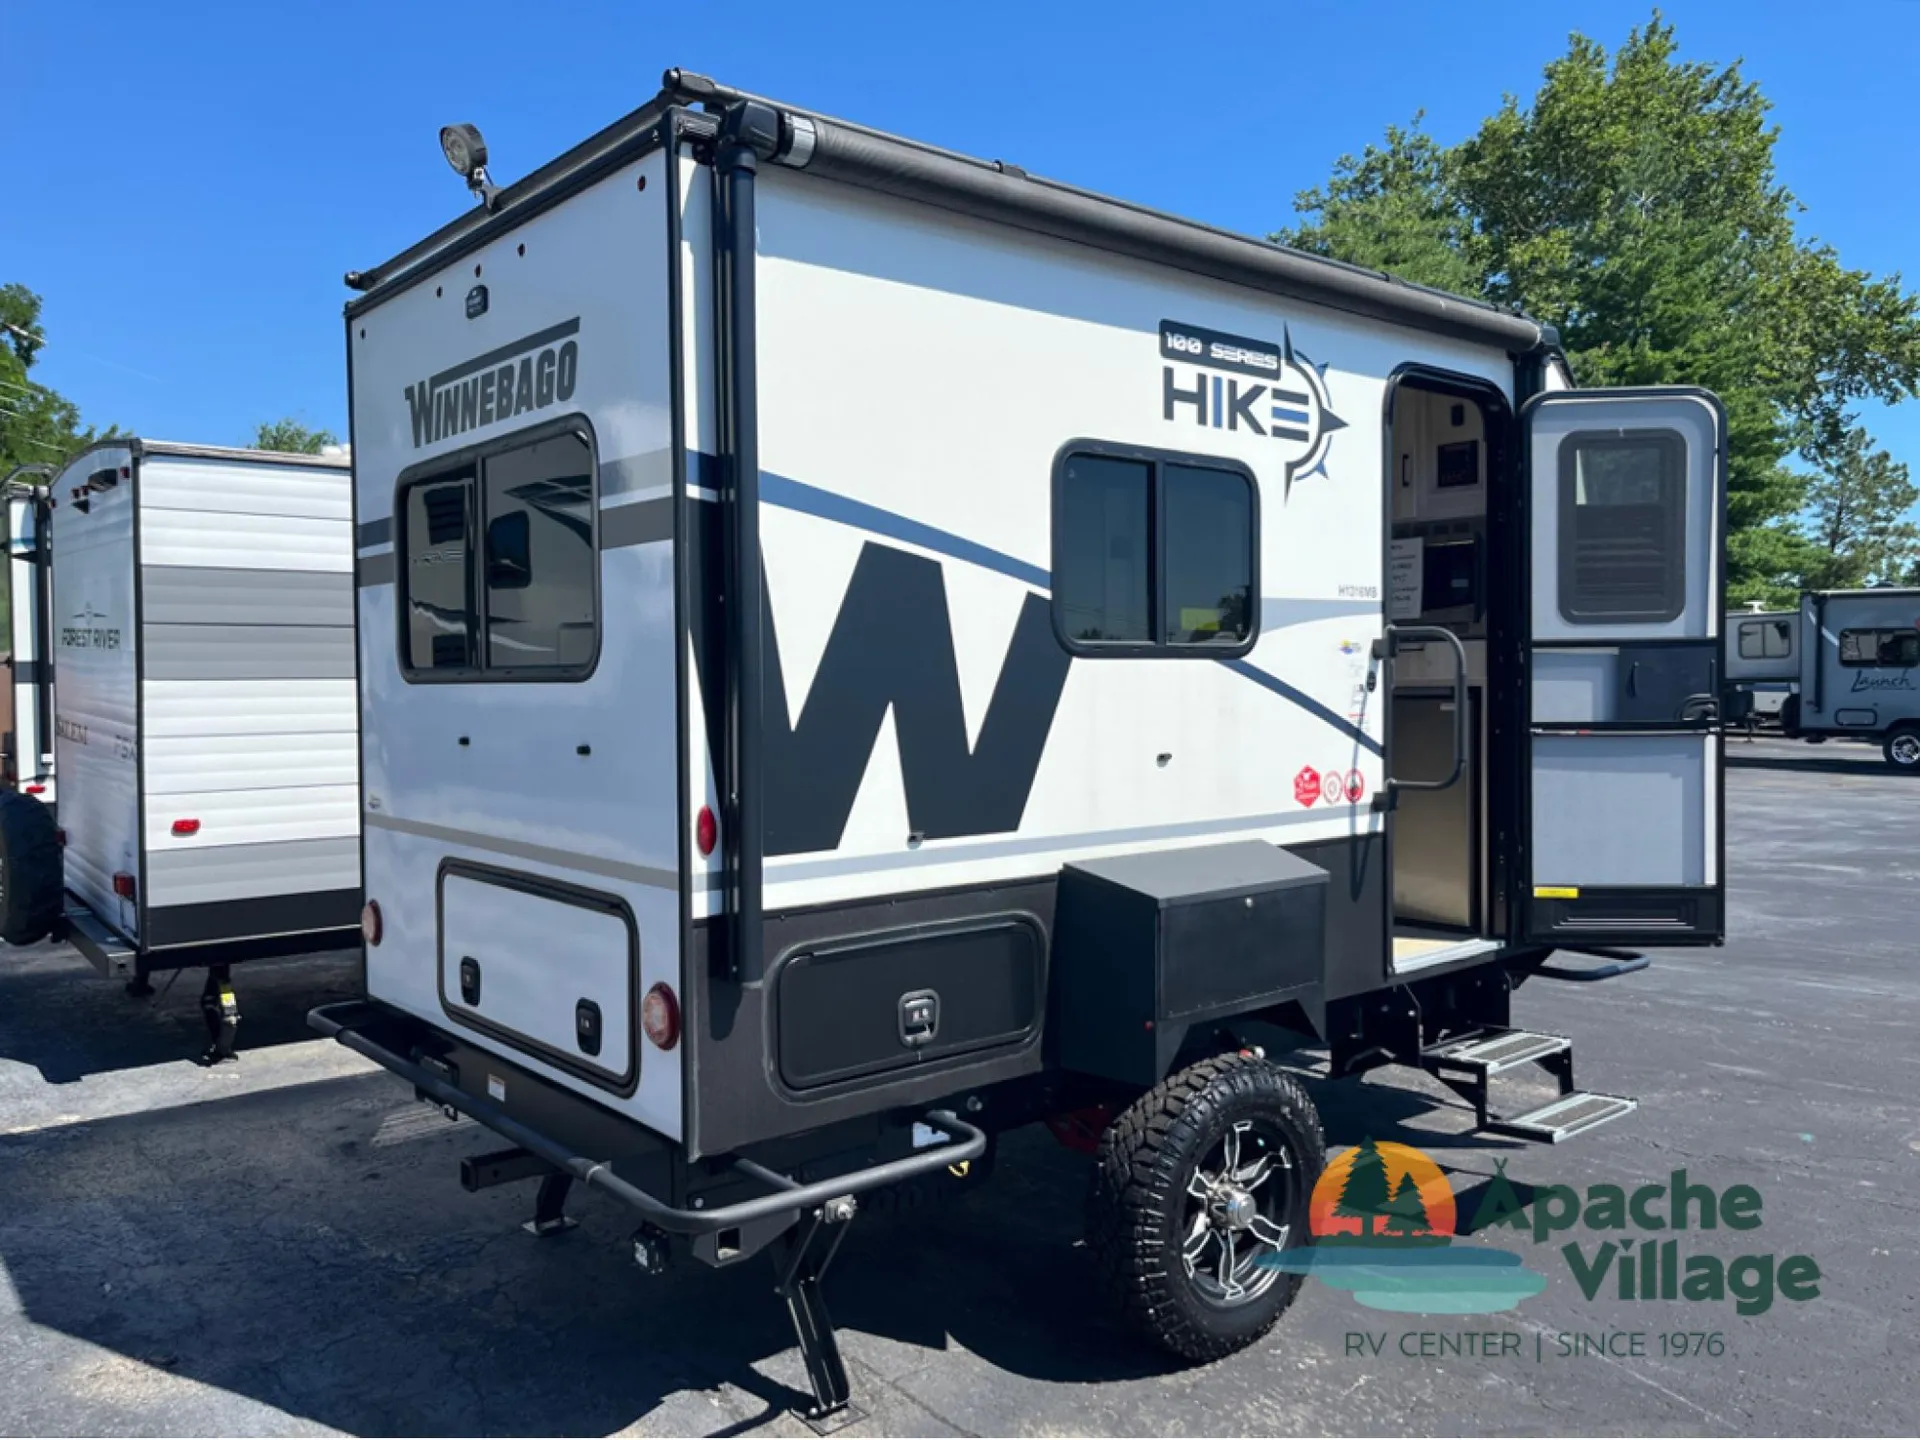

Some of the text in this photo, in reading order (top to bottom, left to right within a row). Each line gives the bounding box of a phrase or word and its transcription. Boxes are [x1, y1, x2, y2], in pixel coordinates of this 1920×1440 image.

[1165, 331, 1278, 370] 100 SERIES
[404, 338, 578, 449] WINNEBAGO
[1163, 365, 1309, 443] HIKE
[62, 627, 121, 649] FOREST RIVER
[1851, 668, 1914, 693] Launch
